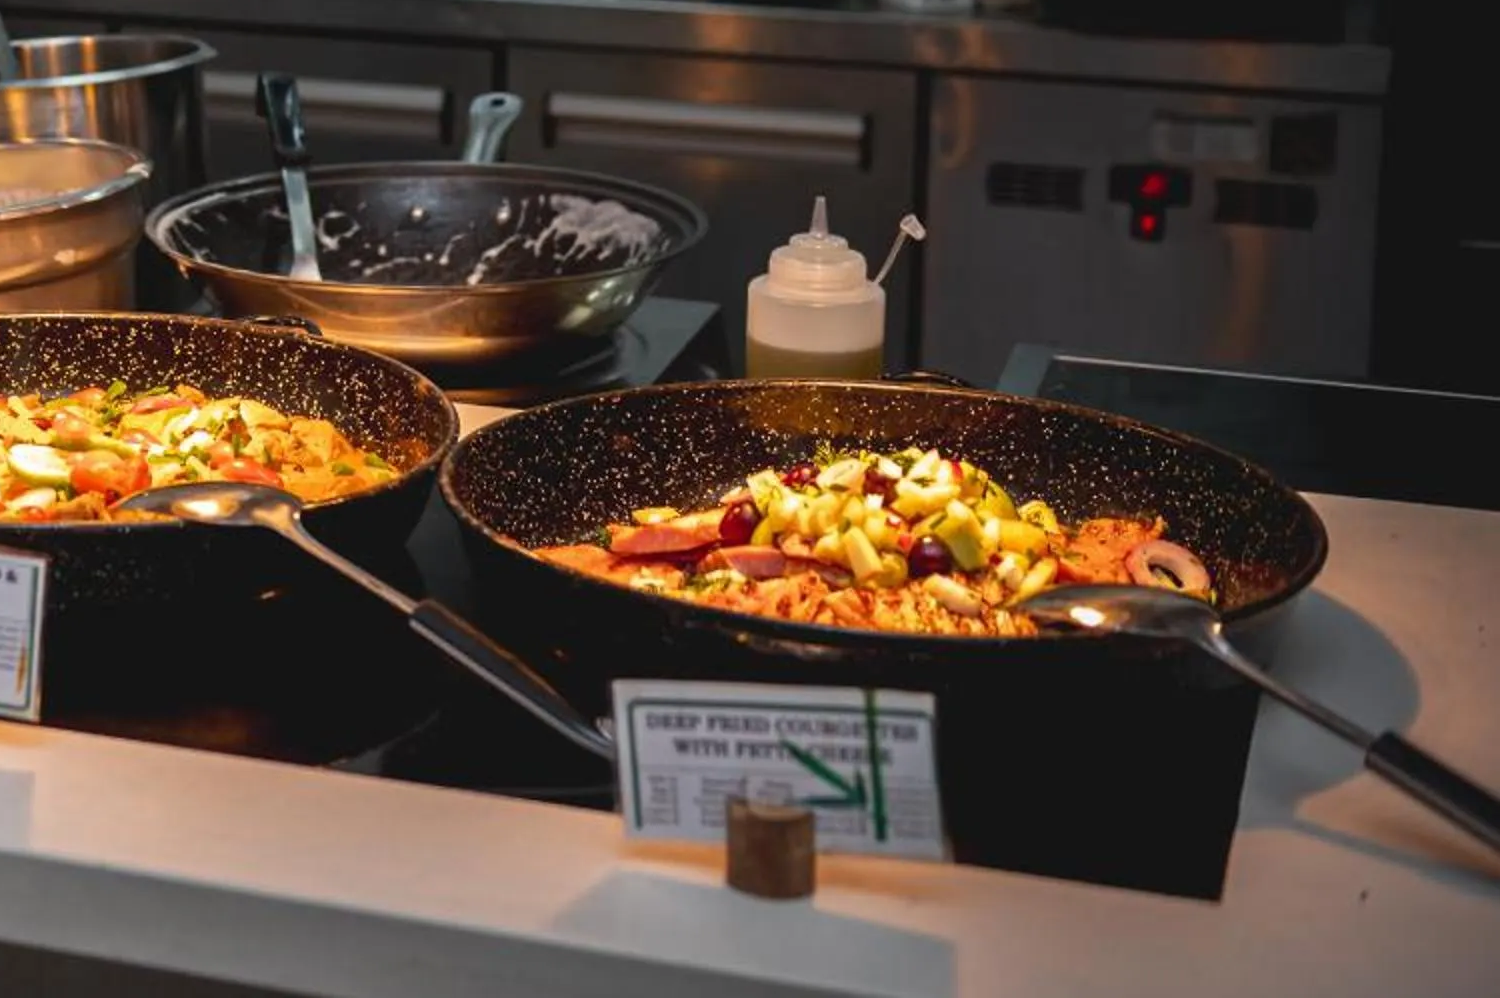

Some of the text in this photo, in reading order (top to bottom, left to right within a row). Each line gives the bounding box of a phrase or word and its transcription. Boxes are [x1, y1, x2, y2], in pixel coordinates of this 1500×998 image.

[6, 568, 18, 585] &
[645, 711, 702, 731] DEEP
[706, 714, 771, 733] FRIED
[672, 736, 730, 758] WITH
